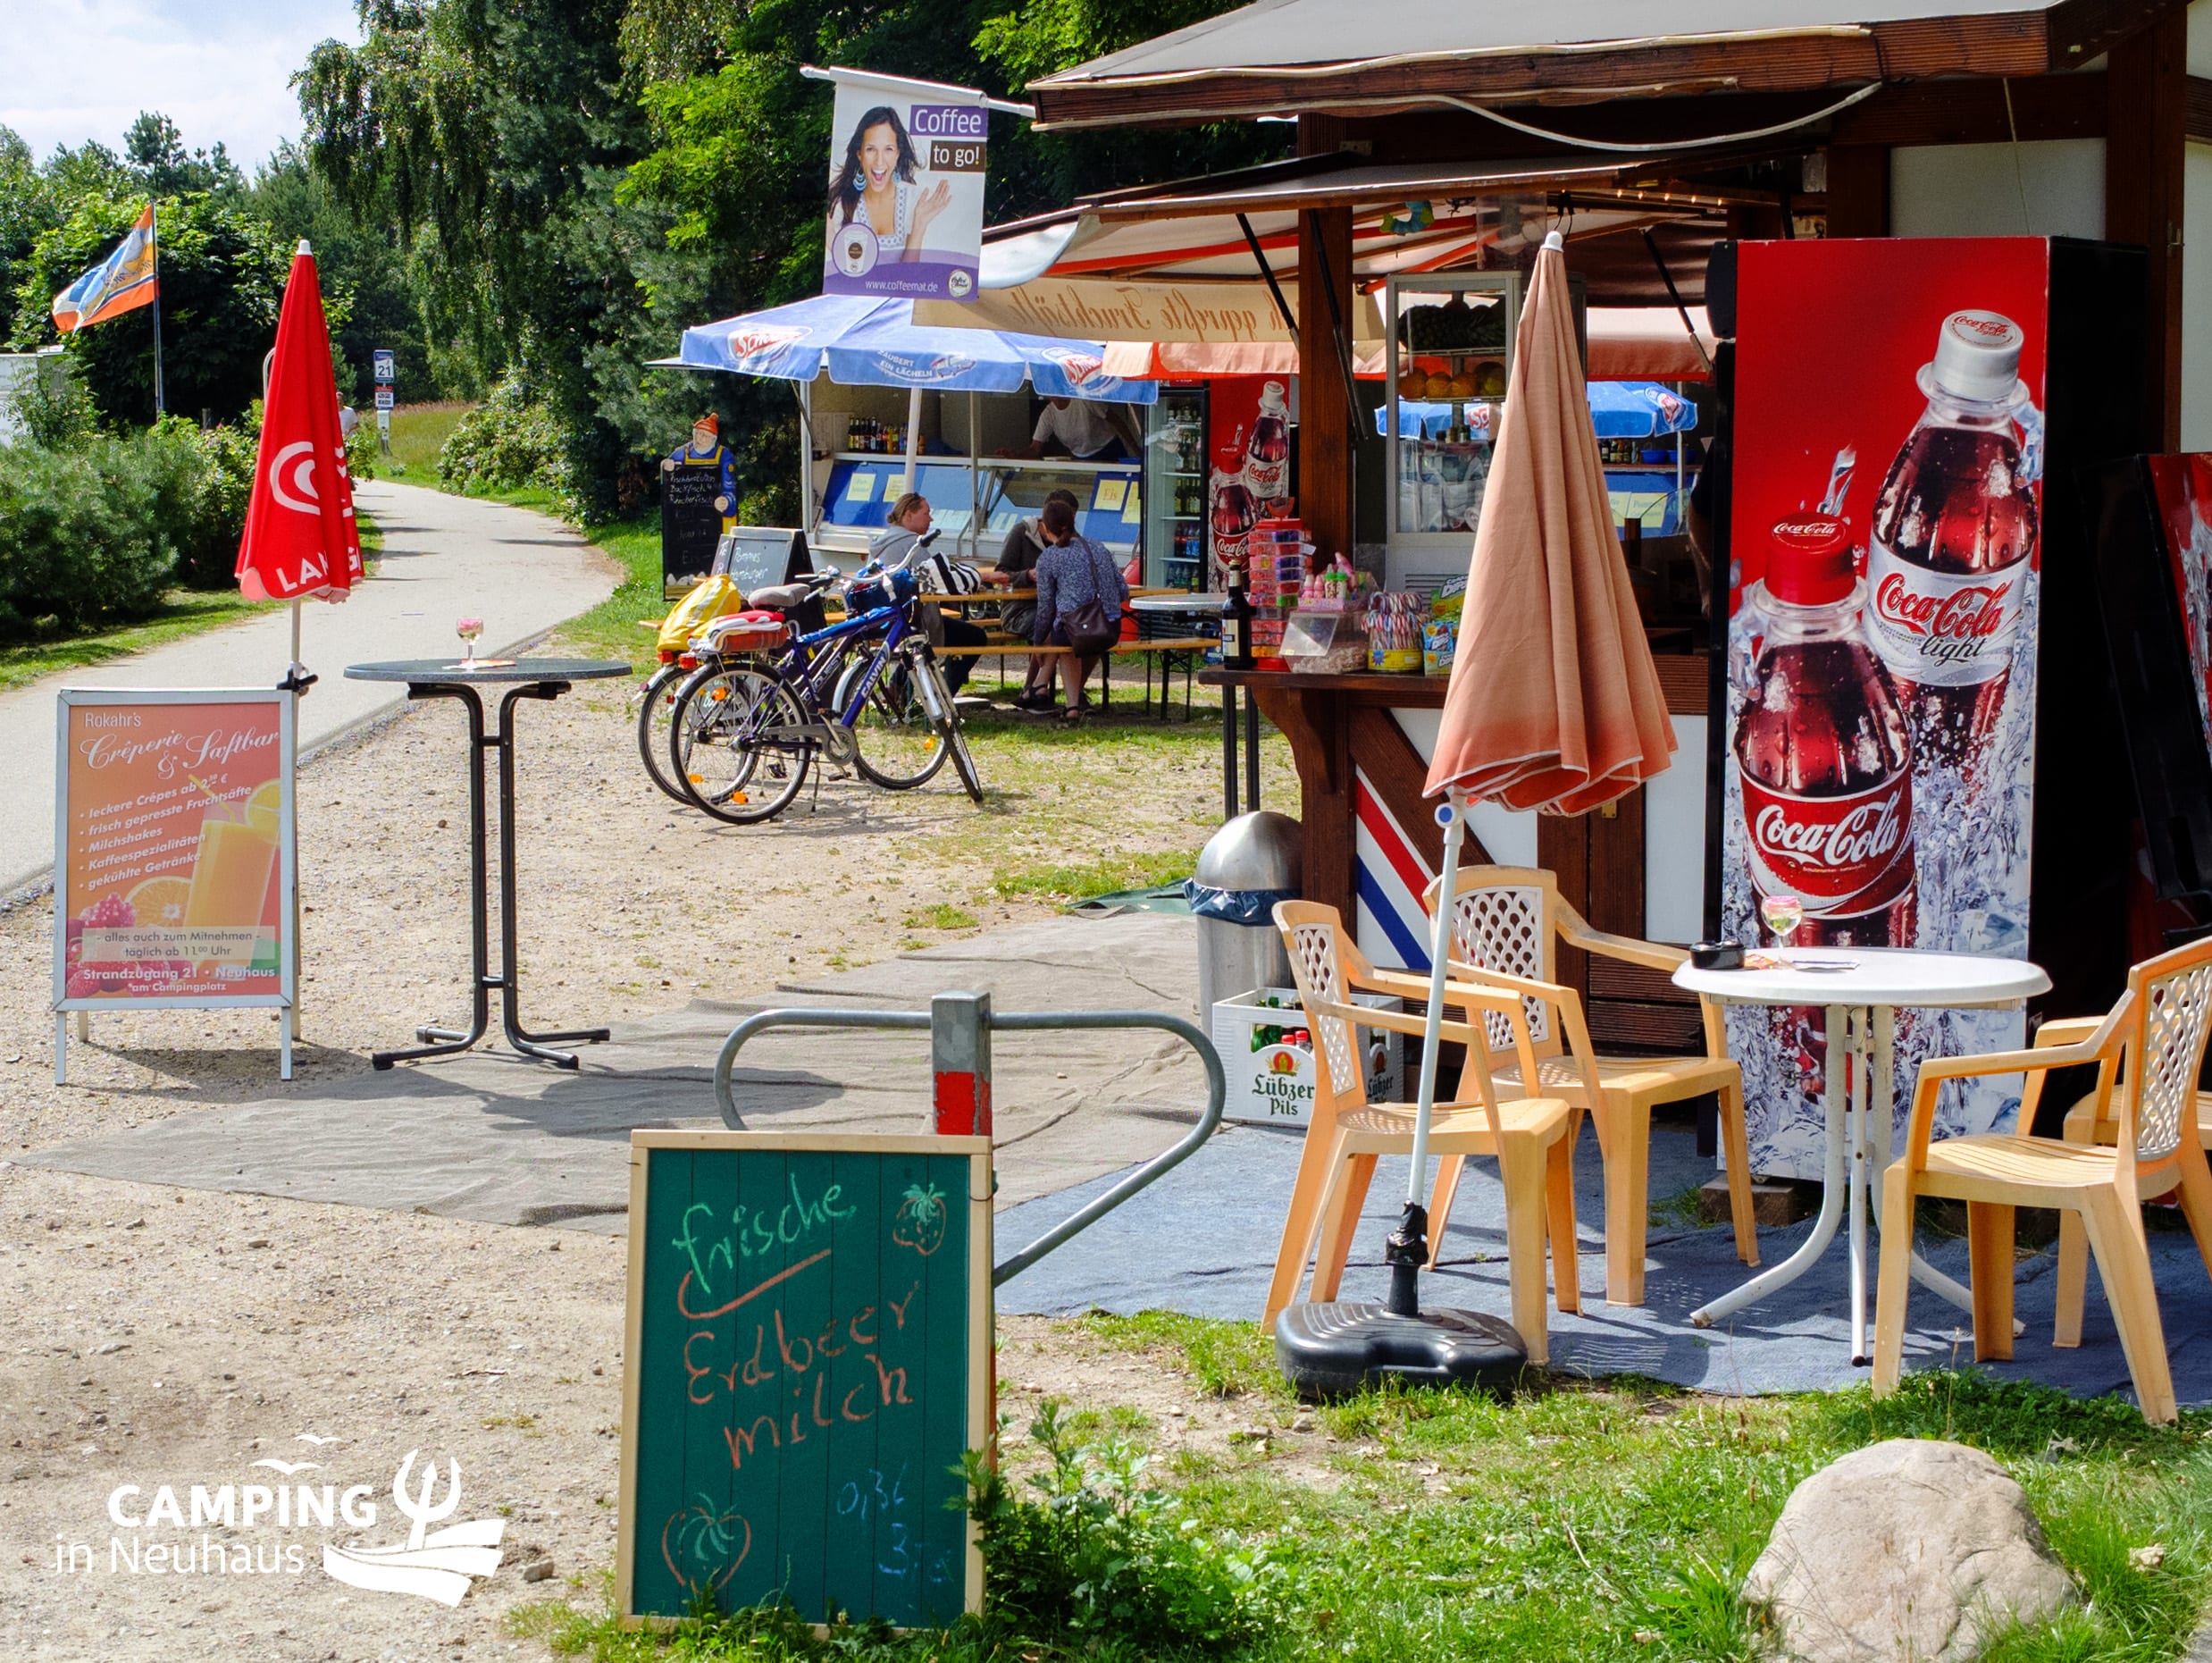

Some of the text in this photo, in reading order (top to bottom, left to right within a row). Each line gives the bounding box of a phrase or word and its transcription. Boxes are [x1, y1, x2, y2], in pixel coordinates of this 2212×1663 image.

[915, 108, 981, 133] Coffee
[934, 145, 981, 168] to go!
[865, 280, 938, 293] www.coffeemat.de
[1954, 315, 2010, 334] Coca-Cola
[877, 349, 915, 367] ZAUBERT
[879, 359, 933, 377] EIN LÄCHELN
[378, 365, 391, 376] 21
[1249, 462, 1282, 483] Coca-Cola
[1773, 523, 1839, 534] Coca-Cola
[1876, 572, 2013, 637] Coca-Cola
[1920, 635, 1985, 667] light
[85, 712, 141, 728] Rokahr's
[80, 727, 280, 769] Crêperie Saftbar
[157, 751, 178, 780] &
[88, 785, 252, 836] frisch gepresste Fruchtsäfte
[89, 801, 133, 819] leckere
[137, 788, 178, 808] Crêpes
[181, 779, 197, 795] ab
[1755, 784, 1903, 867] Coca-Cola
[88, 827, 163, 853] Milchshakes
[88, 833, 206, 871] Kaffeespezialitäten
[88, 851, 201, 891] gekühlte Getränke
[105, 930, 252, 943] alles auch zum Mitnehmen
[125, 946, 163, 959] täglich
[165, 946, 180, 956] ab
[211, 945, 232, 956] Uhr
[84, 965, 275, 981] Strandzugang 21 Neuhaus
[152, 982, 227, 994] Campingplatz
[1252, 1073, 1315, 1102] Lübzer
[1270, 1097, 1298, 1116] Pils
[672, 1172, 857, 1293] frische
[684, 1280, 920, 1404] Erdbeer
